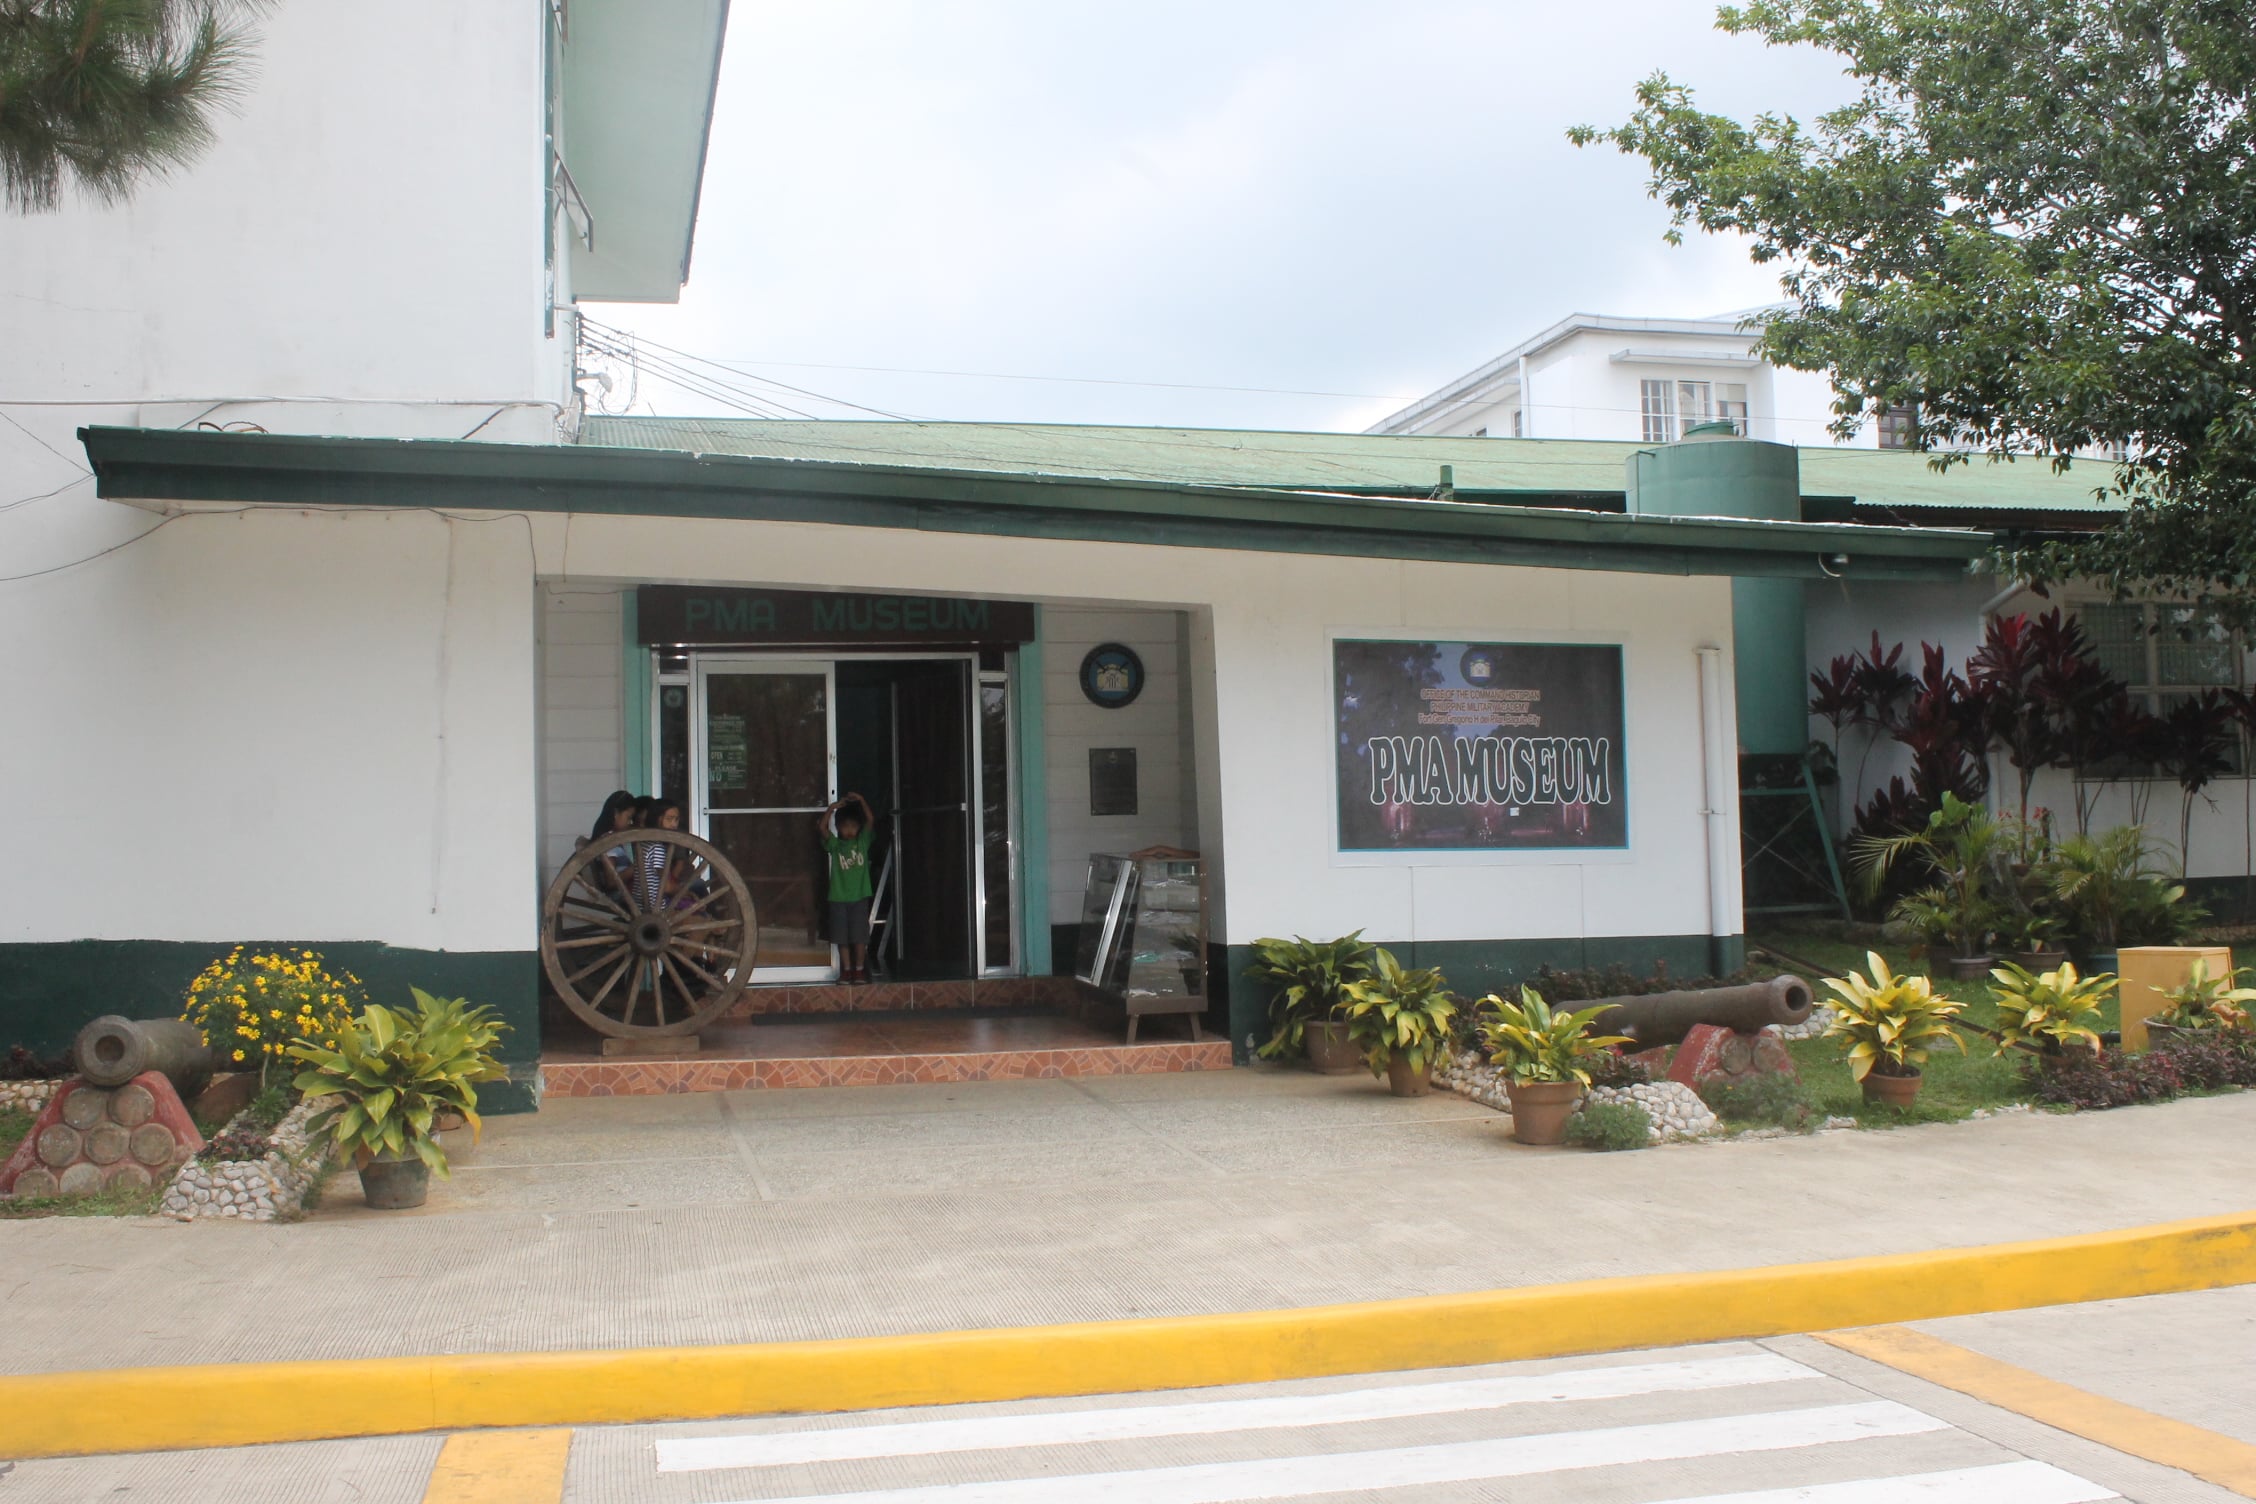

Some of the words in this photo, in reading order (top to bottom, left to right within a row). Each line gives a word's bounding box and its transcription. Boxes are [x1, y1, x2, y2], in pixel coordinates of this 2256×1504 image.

[685, 599, 776, 632] PMA
[812, 598, 990, 633] MUSEUM
[1455, 689, 1469, 700] THE
[1368, 736, 1453, 805] PMA
[1454, 736, 1611, 805] MUSEUM
